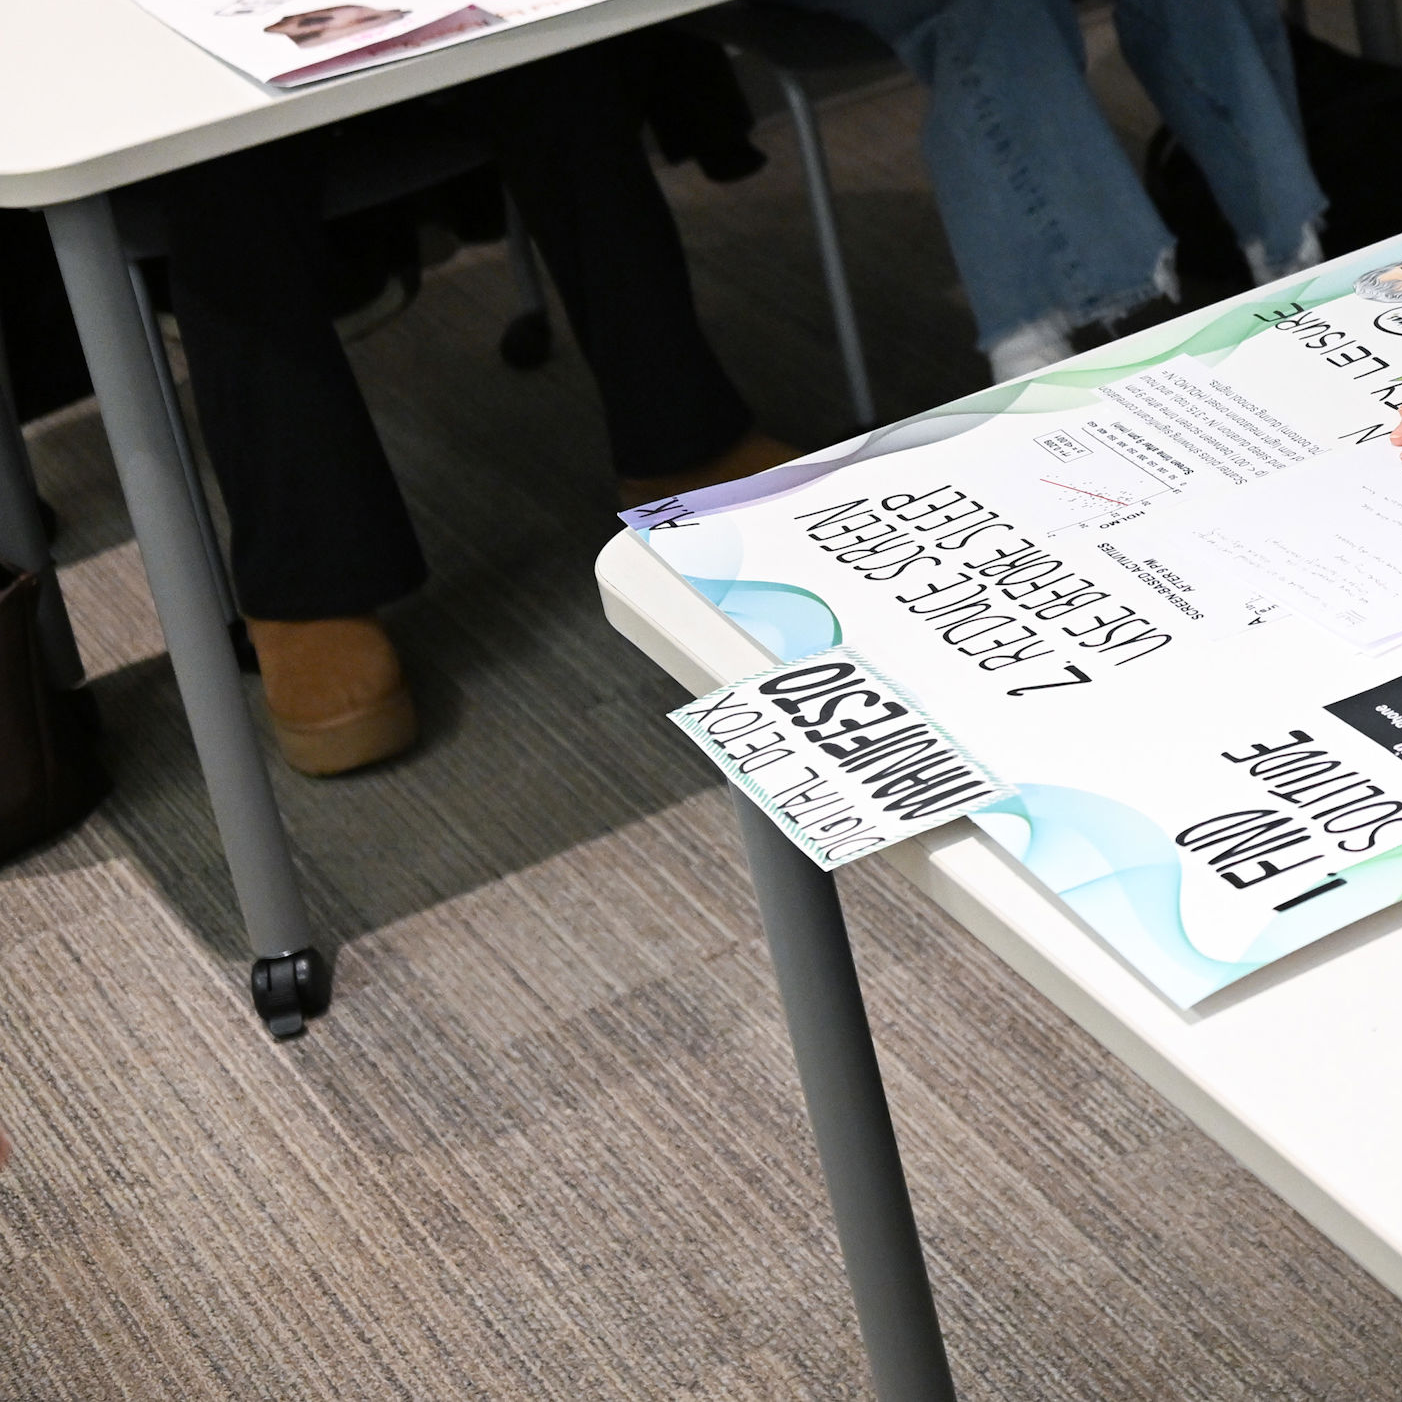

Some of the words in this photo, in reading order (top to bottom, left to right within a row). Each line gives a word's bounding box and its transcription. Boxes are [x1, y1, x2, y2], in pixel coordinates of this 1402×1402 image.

[1253, 302, 1390, 379] LEISURE
[1125, 385, 1144, 394] pm
[1139, 375, 1163, 389] hour
[1152, 384, 1174, 395] and
[1097, 384, 1141, 413] correlation
[1134, 390, 1146, 399] 9
[1142, 396, 1163, 409] after
[1203, 396, 1233, 414] onset
[1229, 394, 1264, 412] school
[1133, 409, 1173, 434] significant
[1159, 407, 1183, 420] time
[1225, 411, 1265, 437] melatonin
[1253, 409, 1282, 427] during
[1110, 422, 1132, 434] (min)
[1122, 430, 1142, 442] pm
[1175, 418, 1203, 434] screen
[1217, 426, 1252, 448] duration
[1139, 440, 1159, 451] after
[1168, 432, 1203, 455] showing
[1198, 433, 1233, 457] between
[1258, 434, 1282, 448] light
[1147, 447, 1172, 460] time
[1198, 453, 1224, 466] plots
[1248, 446, 1271, 463] sleep
[1265, 458, 1286, 469] and
[1272, 446, 1296, 459] dim
[1166, 458, 1194, 475] Screen
[1215, 462, 1247, 485] Scatter
[881, 485, 1014, 550] SLEEP
[794, 498, 941, 580] SCREEN
[1097, 543, 1144, 575] ACTIVITIES
[1143, 559, 1162, 569] PM
[963, 539, 1111, 620] BEFORE
[1162, 570, 1194, 592] AFTER
[1138, 573, 1204, 620] SCREEN-BASED
[895, 573, 1055, 671] REDUCE
[1062, 606, 1172, 666] USE
[1007, 661, 1092, 696] 2.
[688, 692, 795, 774] DETOX
[758, 662, 997, 821] MANIFESTO
[773, 766, 886, 862] DIGITAL
[1175, 810, 1324, 889] FIND
[1273, 873, 1347, 912] 1.
